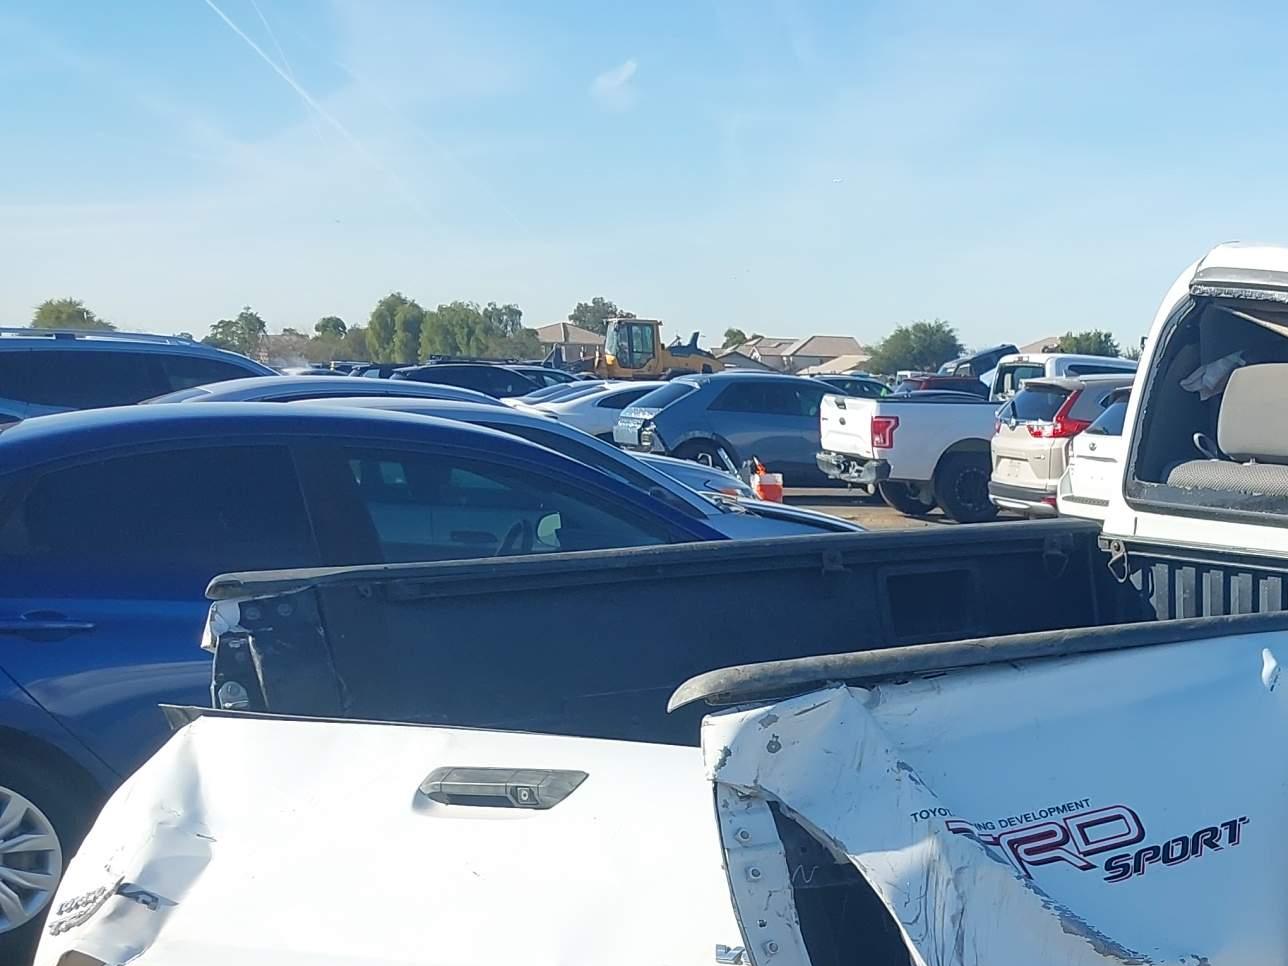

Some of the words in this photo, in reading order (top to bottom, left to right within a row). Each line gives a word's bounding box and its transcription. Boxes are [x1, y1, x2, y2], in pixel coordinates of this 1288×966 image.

[910, 807, 954, 823] TOYO
[998, 798, 1091, 829] DEVELOPMENT
[1103, 815, 1251, 884] SPORT
